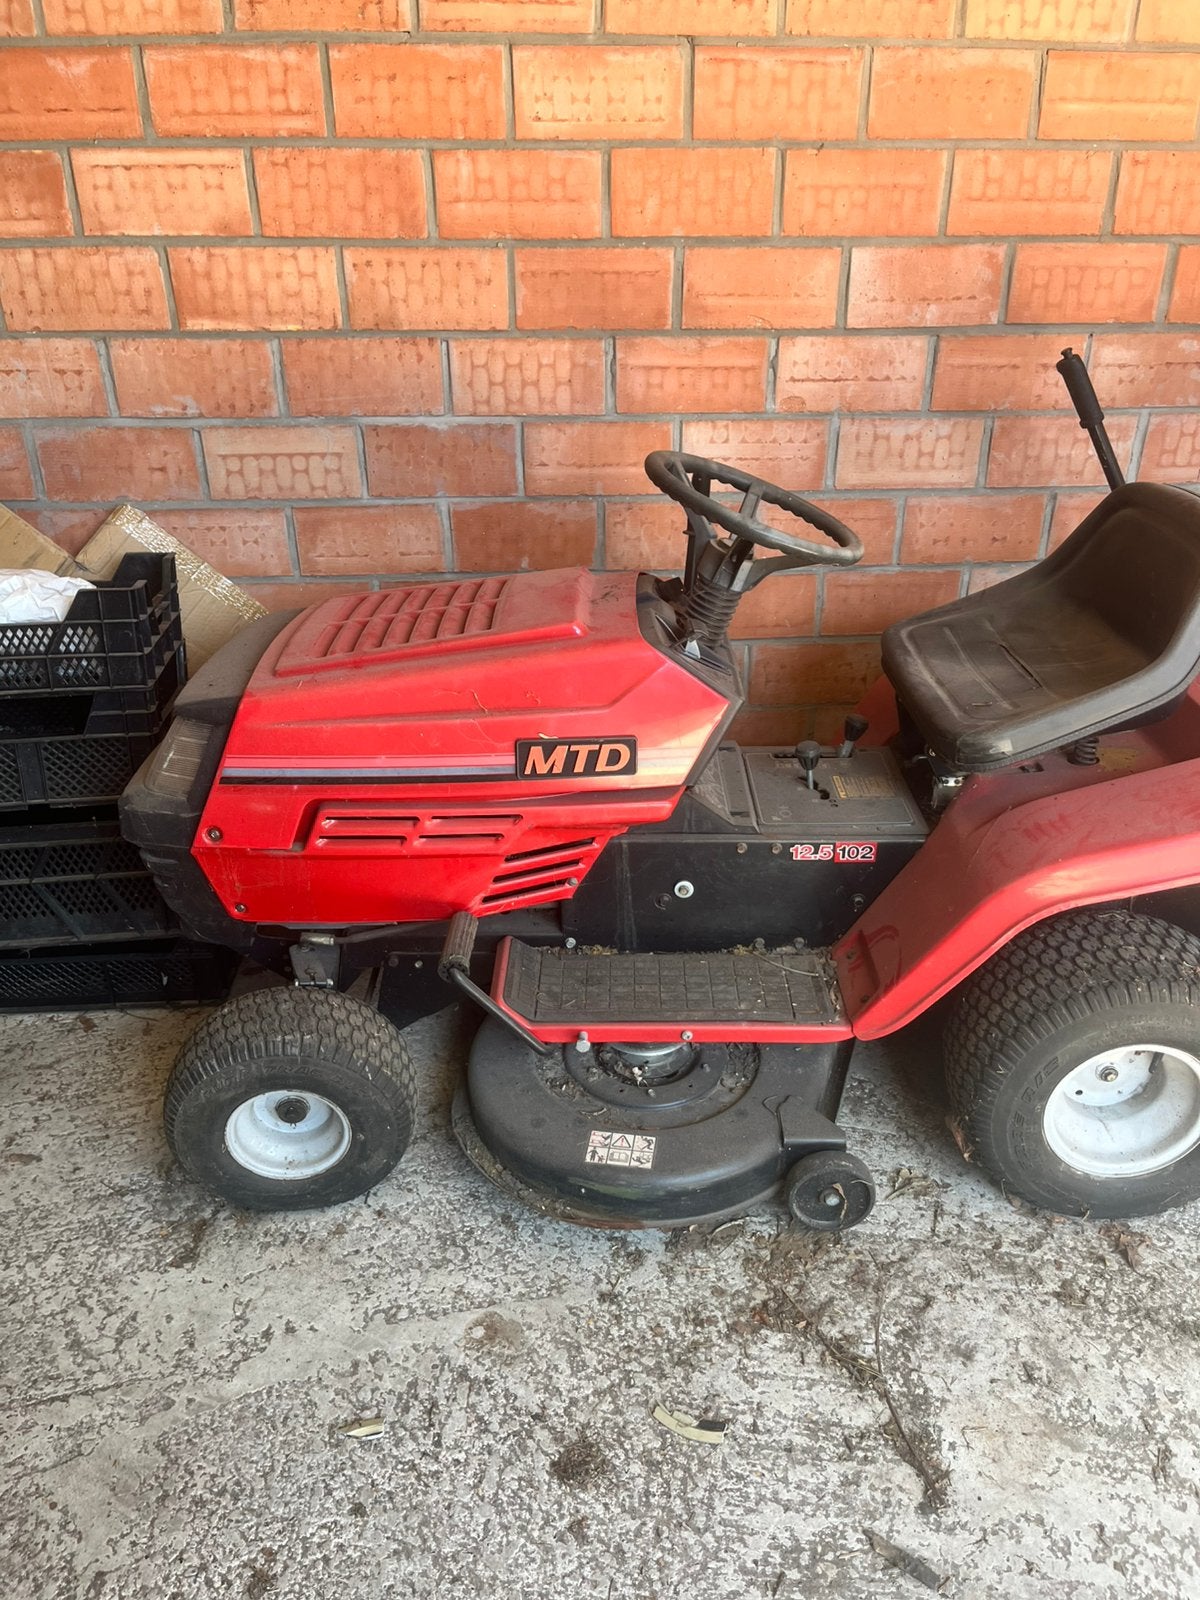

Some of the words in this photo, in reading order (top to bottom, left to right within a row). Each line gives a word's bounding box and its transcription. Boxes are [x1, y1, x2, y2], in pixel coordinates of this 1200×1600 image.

[524, 743, 631, 775] MTD
[790, 844, 834, 861] 12.5
[838, 845, 875, 861] 102
